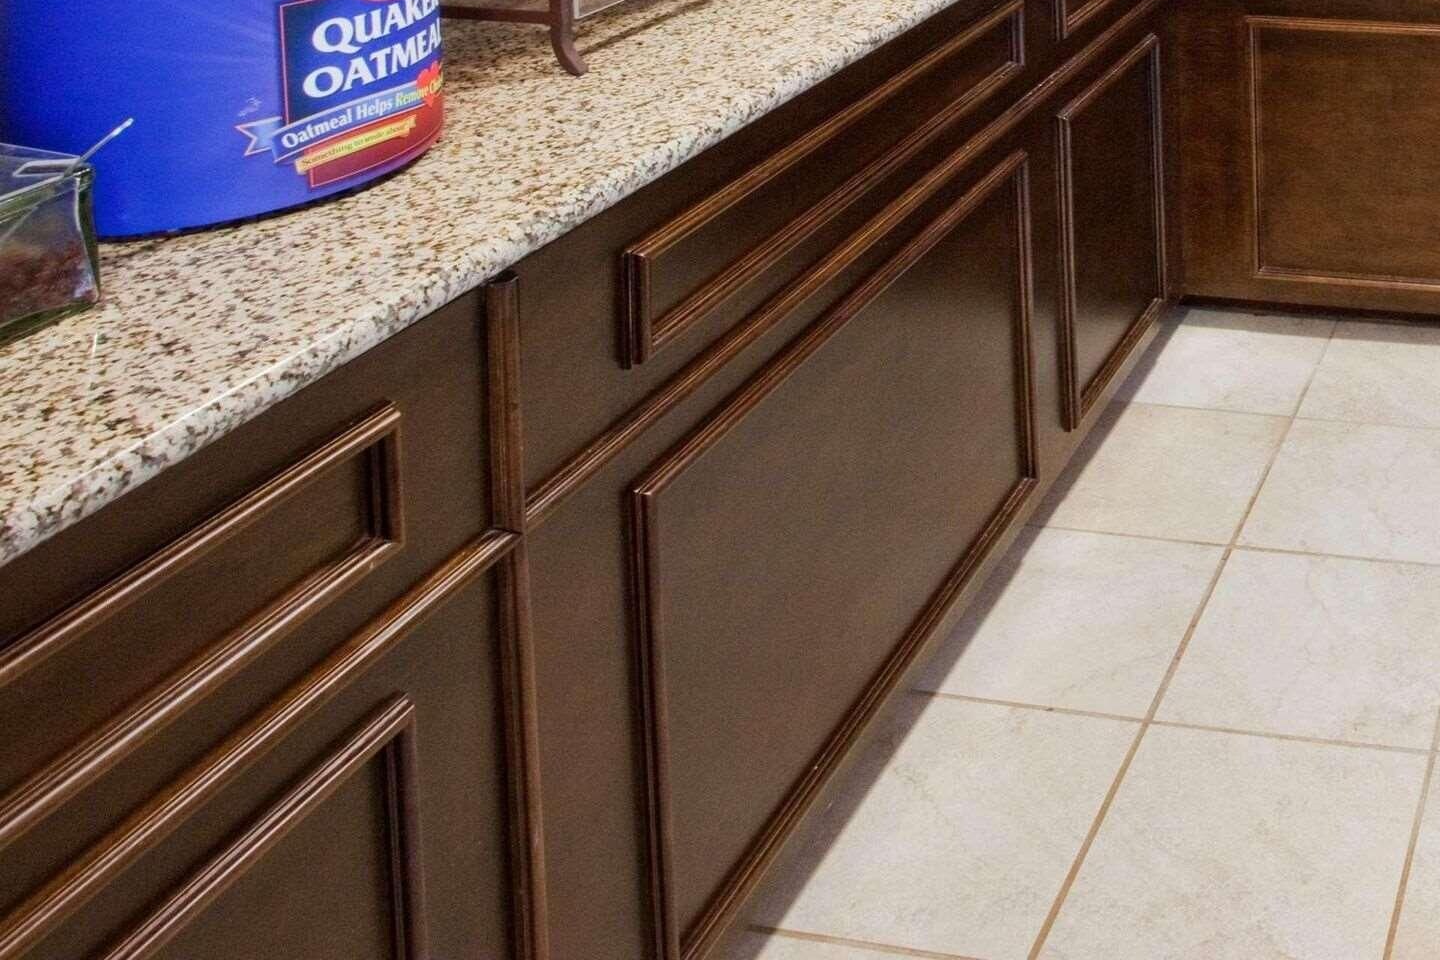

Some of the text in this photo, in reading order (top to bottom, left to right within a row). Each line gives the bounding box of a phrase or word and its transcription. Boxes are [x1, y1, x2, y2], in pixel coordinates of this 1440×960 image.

[302, 18, 442, 99] OATMEAL
[281, 84, 428, 150] Oatmeal Helps Remove
